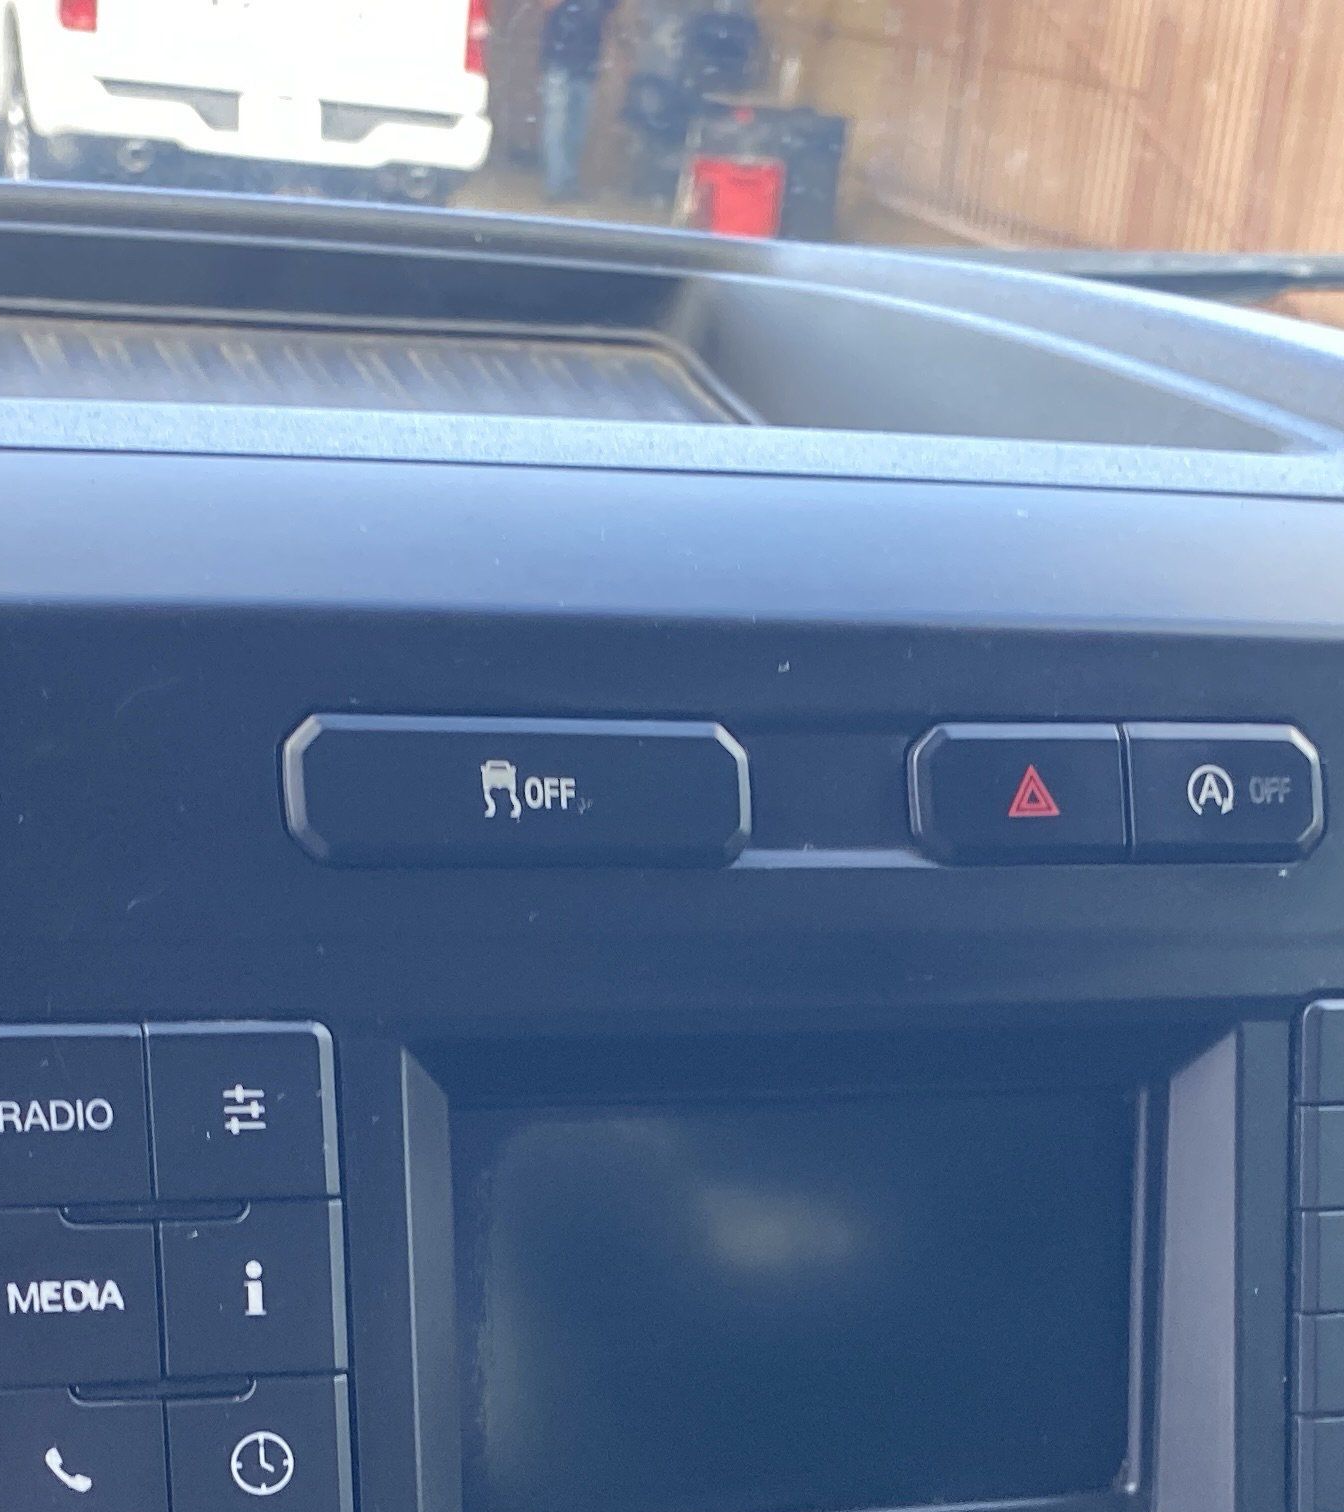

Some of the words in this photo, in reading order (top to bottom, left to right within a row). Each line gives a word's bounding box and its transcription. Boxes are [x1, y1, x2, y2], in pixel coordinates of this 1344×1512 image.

[524, 776, 576, 810] OFF
[1248, 775, 1291, 804] OFF
[6, 1279, 125, 1314] MEDIA
